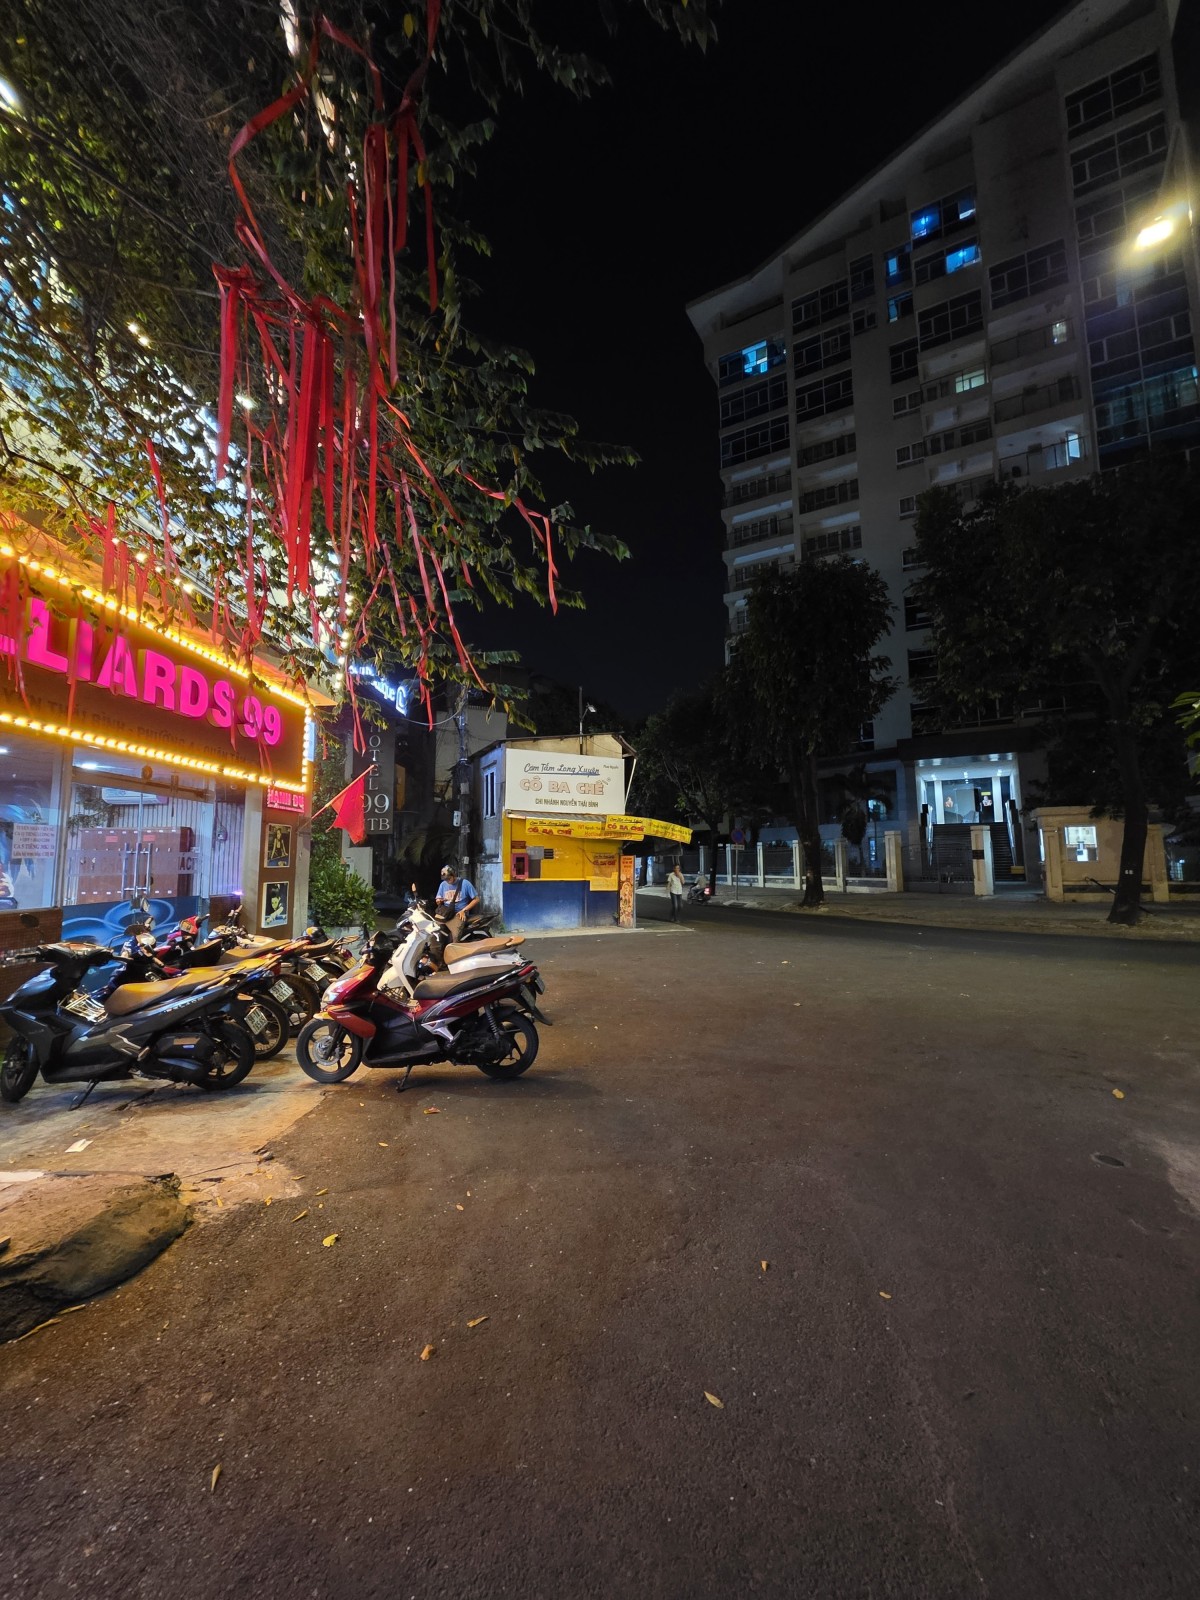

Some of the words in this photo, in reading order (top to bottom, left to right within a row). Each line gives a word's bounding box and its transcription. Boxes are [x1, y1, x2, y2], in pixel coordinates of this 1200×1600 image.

[0, 596, 236, 728] LIARDS
[237, 695, 282, 746] 99
[519, 775, 543, 792] CÔ
[548, 780, 571, 794] BA
[544, 798, 559, 806] NHÁNH
[560, 798, 577, 807] NGUYỄN
[578, 799, 588, 808] THÁI
[588, 800, 599, 808] BÌNH
[363, 817, 391, 831] TB
